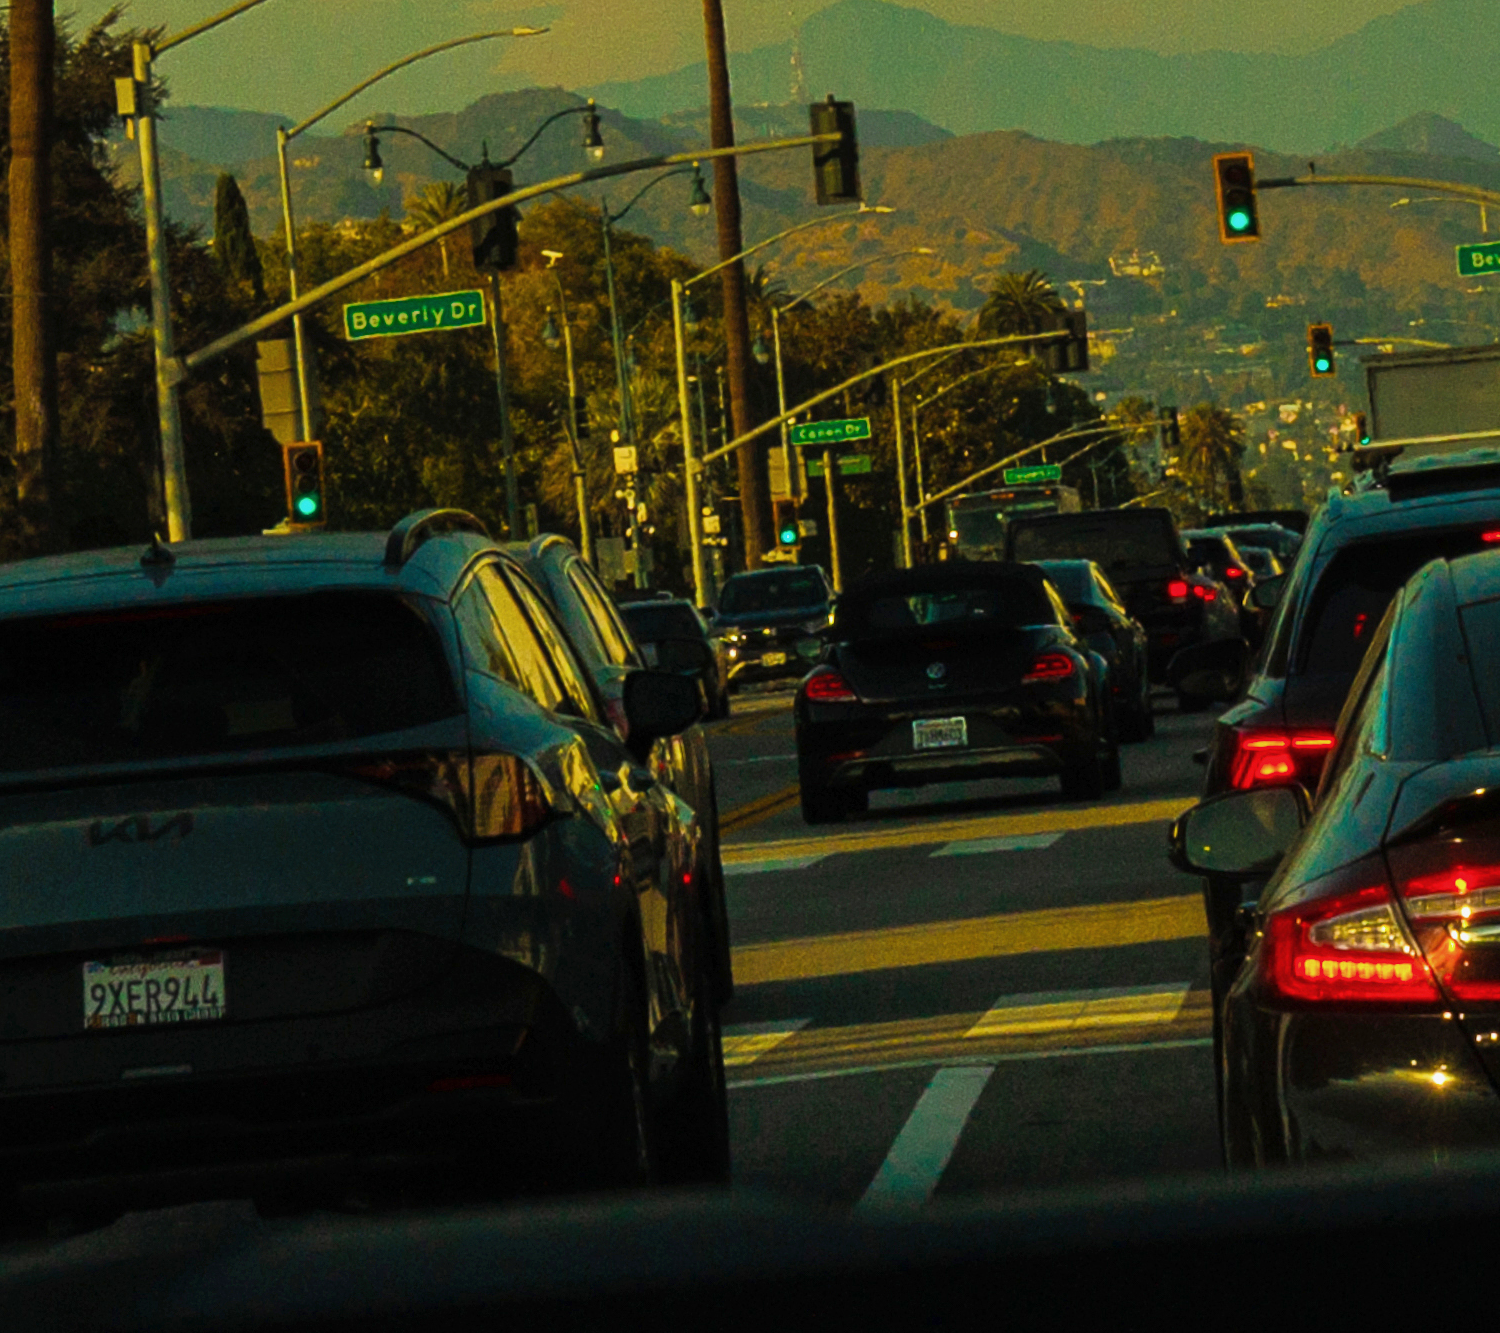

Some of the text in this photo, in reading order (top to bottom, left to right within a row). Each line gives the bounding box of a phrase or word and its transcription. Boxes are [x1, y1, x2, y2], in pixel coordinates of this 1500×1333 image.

[352, 301, 476, 331] Beverly Dr
[90, 974, 218, 1021] 9XER944
